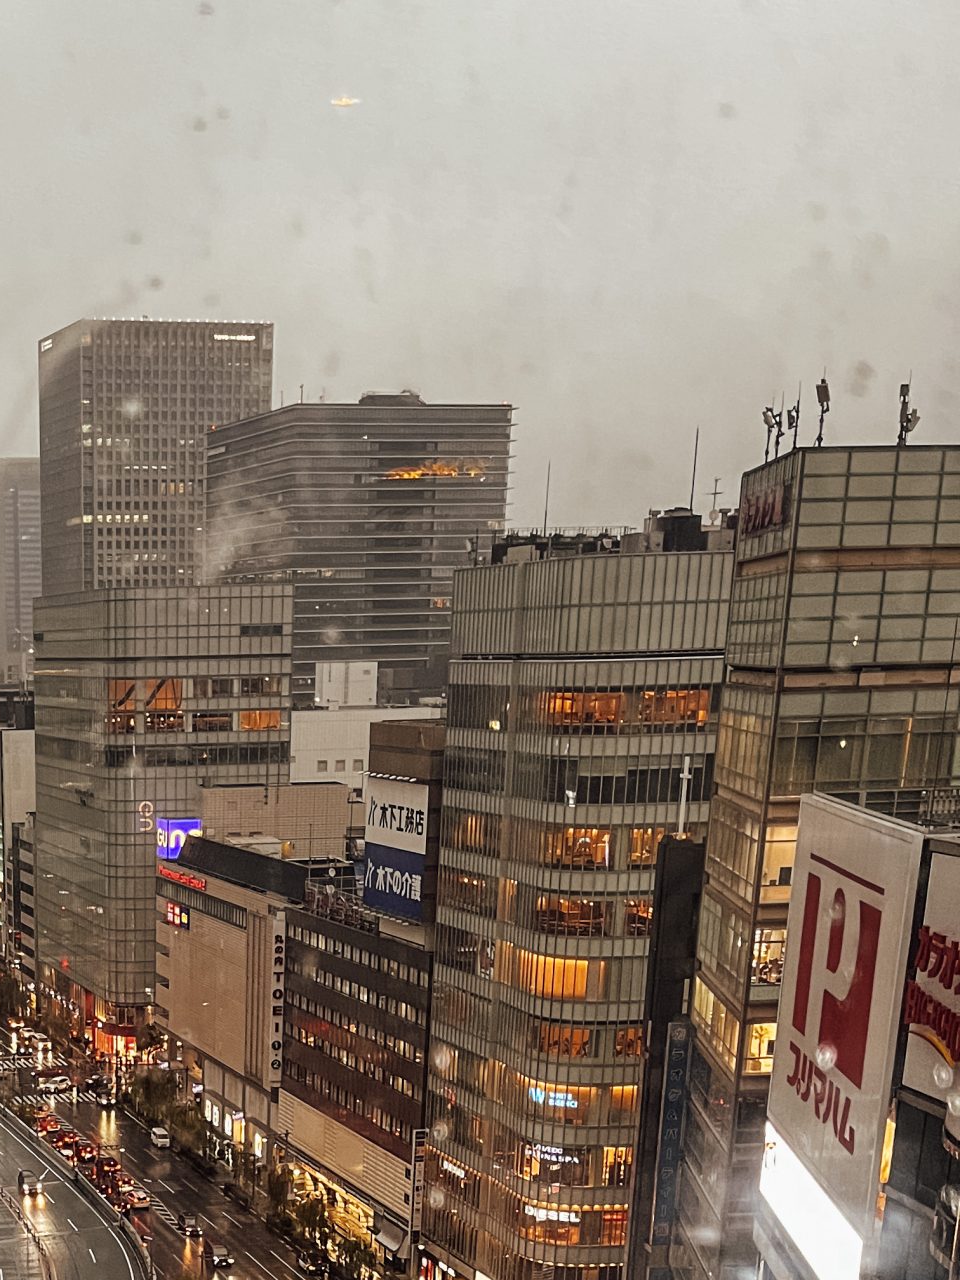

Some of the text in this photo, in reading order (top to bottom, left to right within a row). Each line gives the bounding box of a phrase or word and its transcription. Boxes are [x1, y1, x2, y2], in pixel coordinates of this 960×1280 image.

[379, 803, 425, 836] 木下工務店
[375, 865, 422, 902] 木下の介護
[914, 924, 960, 996] カラオ
[786, 1040, 855, 1156] プリマハム
[524, 1204, 582, 1223] DIESEL
